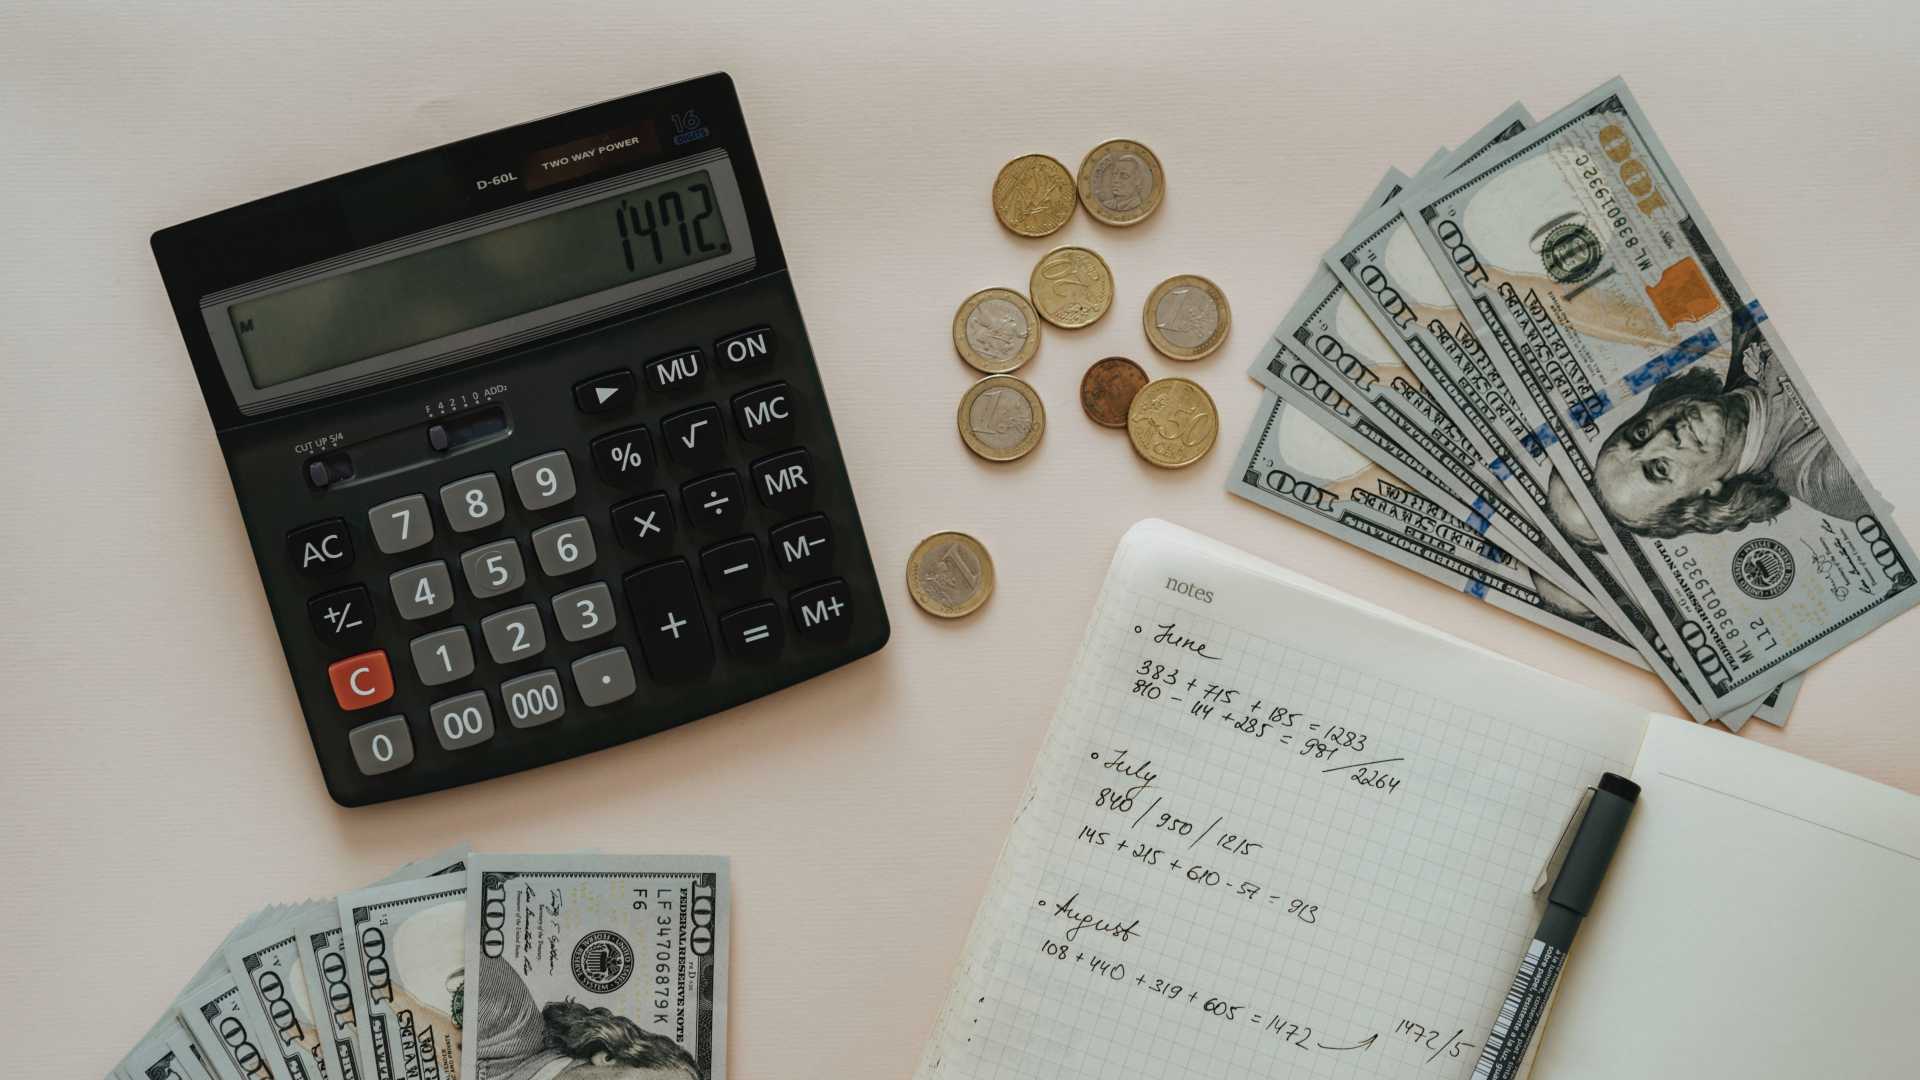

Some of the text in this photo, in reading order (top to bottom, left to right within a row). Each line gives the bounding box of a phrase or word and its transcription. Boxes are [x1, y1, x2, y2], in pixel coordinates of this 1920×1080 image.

[541, 136, 640, 171] TWO WAY POWER
[476, 172, 519, 191] D-60L
[1435, 218, 1488, 288] 100
[1358, 263, 1416, 329] 100
[727, 334, 767, 362] ON
[1311, 334, 1380, 391] 100
[657, 355, 698, 385] MU
[438, 401, 444, 410] 4
[449, 398, 456, 408] 2
[472, 391, 479, 401] 0
[744, 396, 789, 428] MC
[295, 442, 314, 454] CUT
[315, 436, 328, 448] UP
[611, 442, 642, 471] %
[536, 467, 557, 496] 9
[765, 465, 808, 496] MR
[1264, 468, 1339, 513] 100
[465, 489, 489, 518] 8
[391, 509, 411, 540] 7
[302, 534, 344, 568] AC
[556, 533, 578, 562] 6
[1654, 539, 1676, 569] NOTE
[486, 555, 508, 586] 5
[414, 577, 436, 606] 4
[1165, 575, 1215, 603] notes
[1672, 569, 1709, 623] RESERVE
[1682, 557, 1739, 639] 83801932
[576, 599, 598, 629] 3
[661, 612, 687, 638] +
[801, 596, 844, 627] M+
[506, 622, 530, 651] 2
[743, 624, 769, 643] =
[1154, 624, 1222, 661] June
[1704, 620, 1739, 671] FEDERAL
[436, 645, 453, 672] 1
[1678, 618, 1732, 688] 100
[1733, 640, 1754, 662] ML
[350, 667, 376, 697] C
[1136, 660, 1179, 686] 383
[1202, 684, 1240, 704] 715
[1269, 705, 1303, 727] 185
[511, 684, 558, 720] 000
[444, 706, 483, 740] 00
[372, 734, 393, 762] 0
[1300, 738, 1339, 761] 981
[1104, 750, 1161, 798] July
[1350, 767, 1402, 795] 2264
[1095, 788, 1134, 813] 840
[1156, 812, 1193, 836] 950
[1216, 832, 1263, 856] 1215
[1078, 824, 1107, 847] 145
[1132, 842, 1166, 866] 215
[1186, 864, 1221, 887] 610
[632, 889, 647, 910] F6
[482, 883, 505, 959] 100
[690, 880, 712, 956] 100
[1055, 892, 1141, 942] August
[361, 927, 394, 1005] 100
[653, 889, 671, 1024] LF 34706879 K
[676, 887, 687, 1042] FEDERAL RESERVE NOTE
[322, 952, 357, 1030] 100
[1041, 938, 1069, 960] 108
[1202, 997, 1245, 1022] 605
[258, 970, 305, 1047] 100
